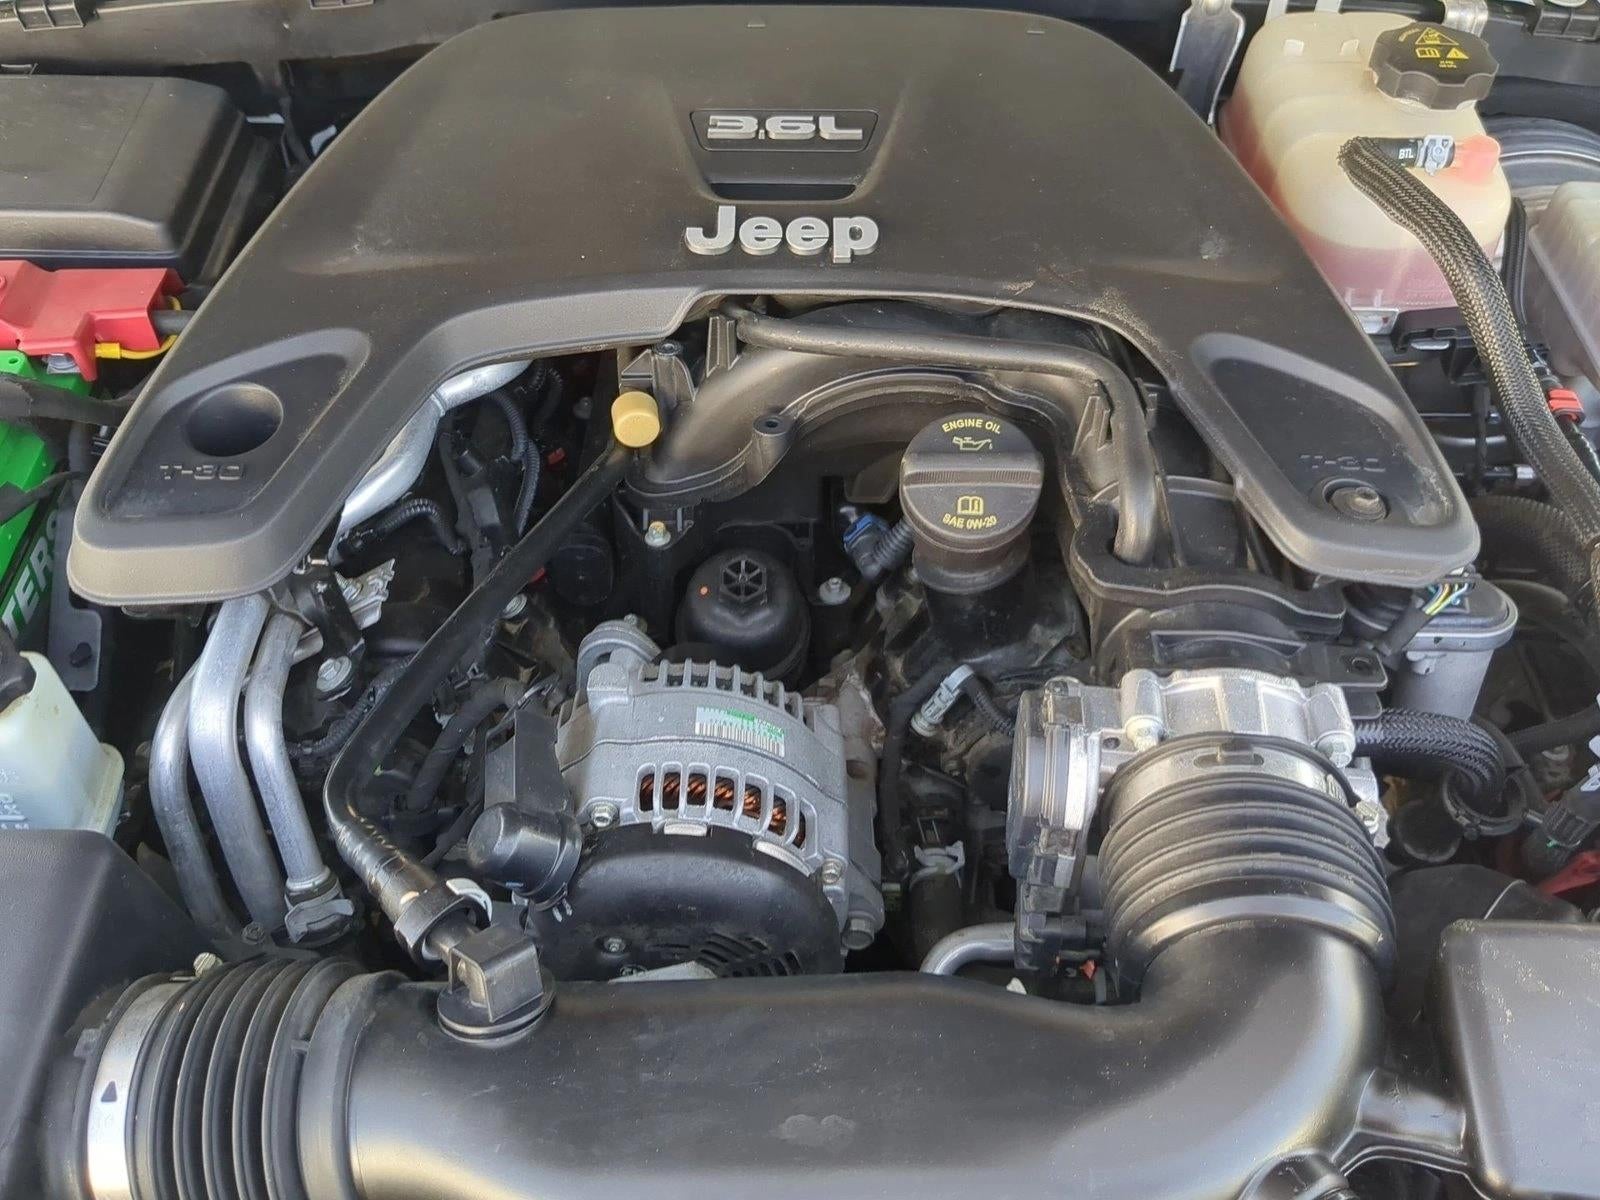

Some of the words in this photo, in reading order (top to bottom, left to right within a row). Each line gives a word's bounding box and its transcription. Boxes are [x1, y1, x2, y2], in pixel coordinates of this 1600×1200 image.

[707, 115, 863, 140] 3.6L
[685, 205, 879, 263] Jeep
[942, 418, 983, 432] ENGINE
[985, 421, 1001, 434] OIL
[943, 513, 965, 529] SAE
[966, 515, 998, 530] 0W-20
